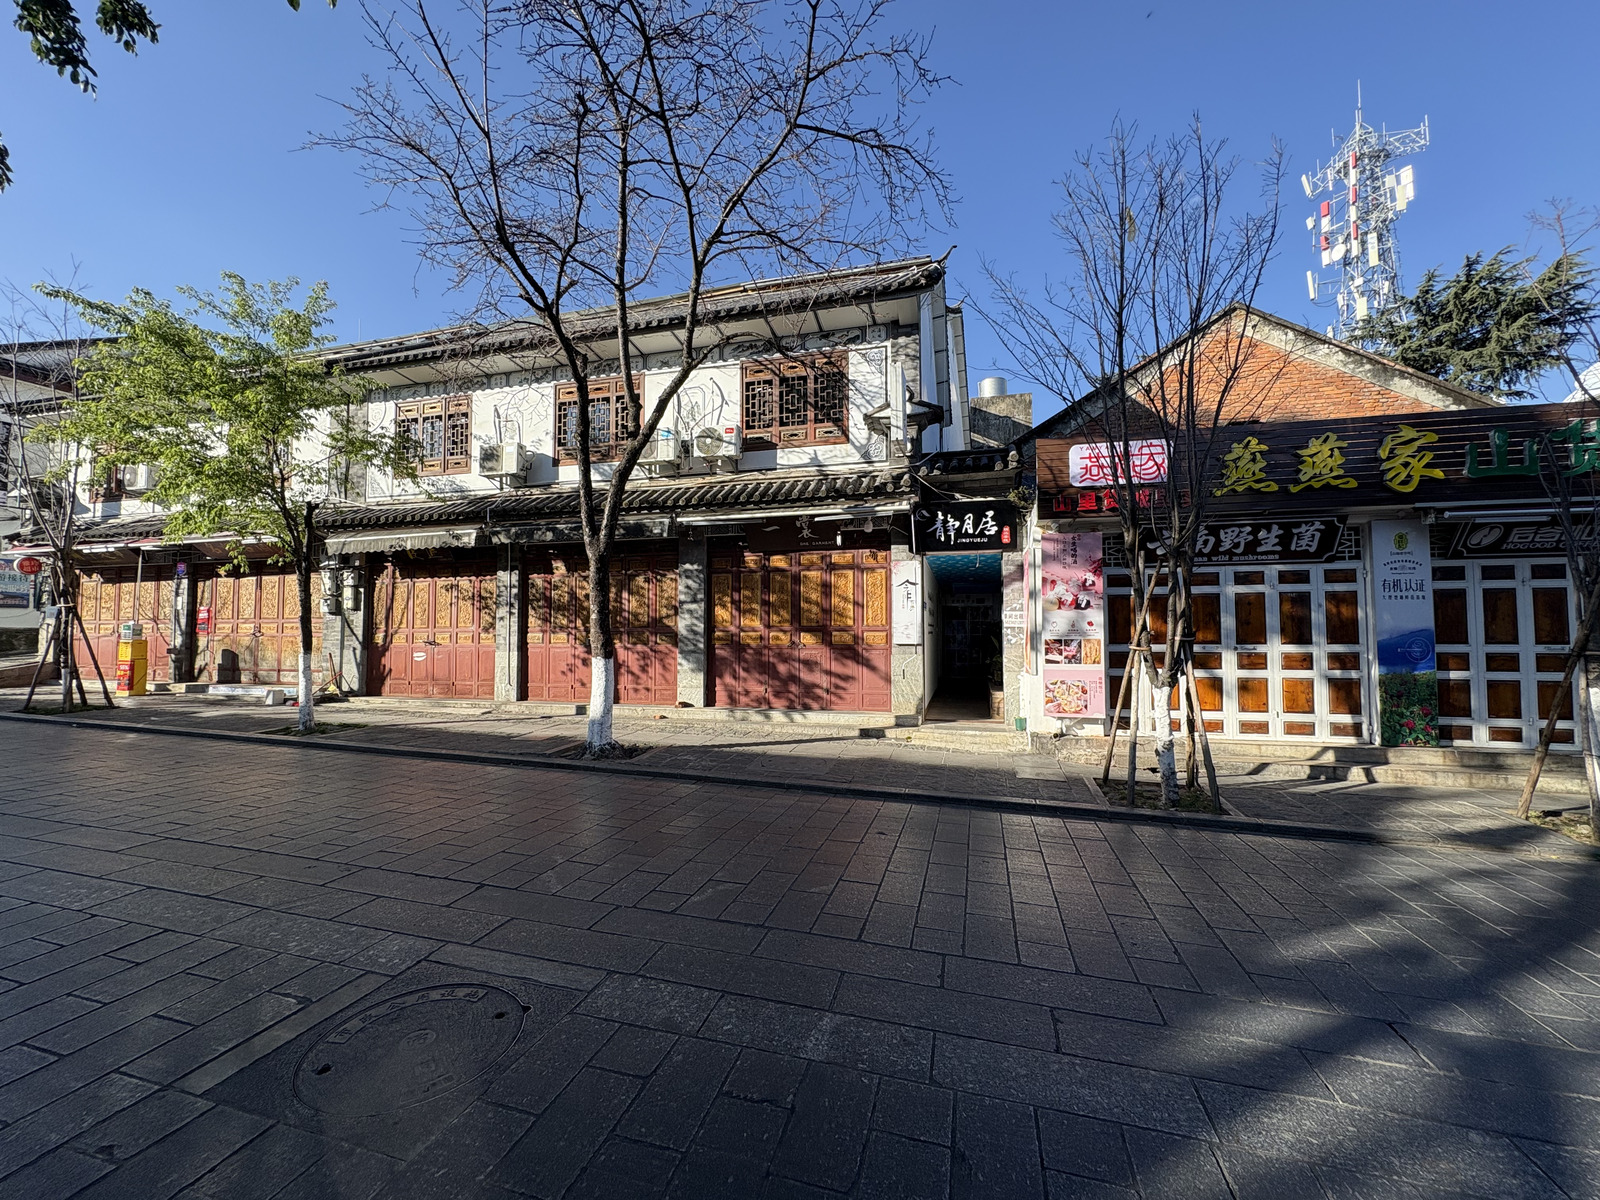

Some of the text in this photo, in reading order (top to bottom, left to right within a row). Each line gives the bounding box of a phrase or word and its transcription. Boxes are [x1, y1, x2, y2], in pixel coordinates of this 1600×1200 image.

[926, 510, 998, 545] 静月居
[1211, 554, 1229, 562] wild
[1232, 553, 1280, 561] mushrooms
[1381, 578, 1426, 593] 有机认证
